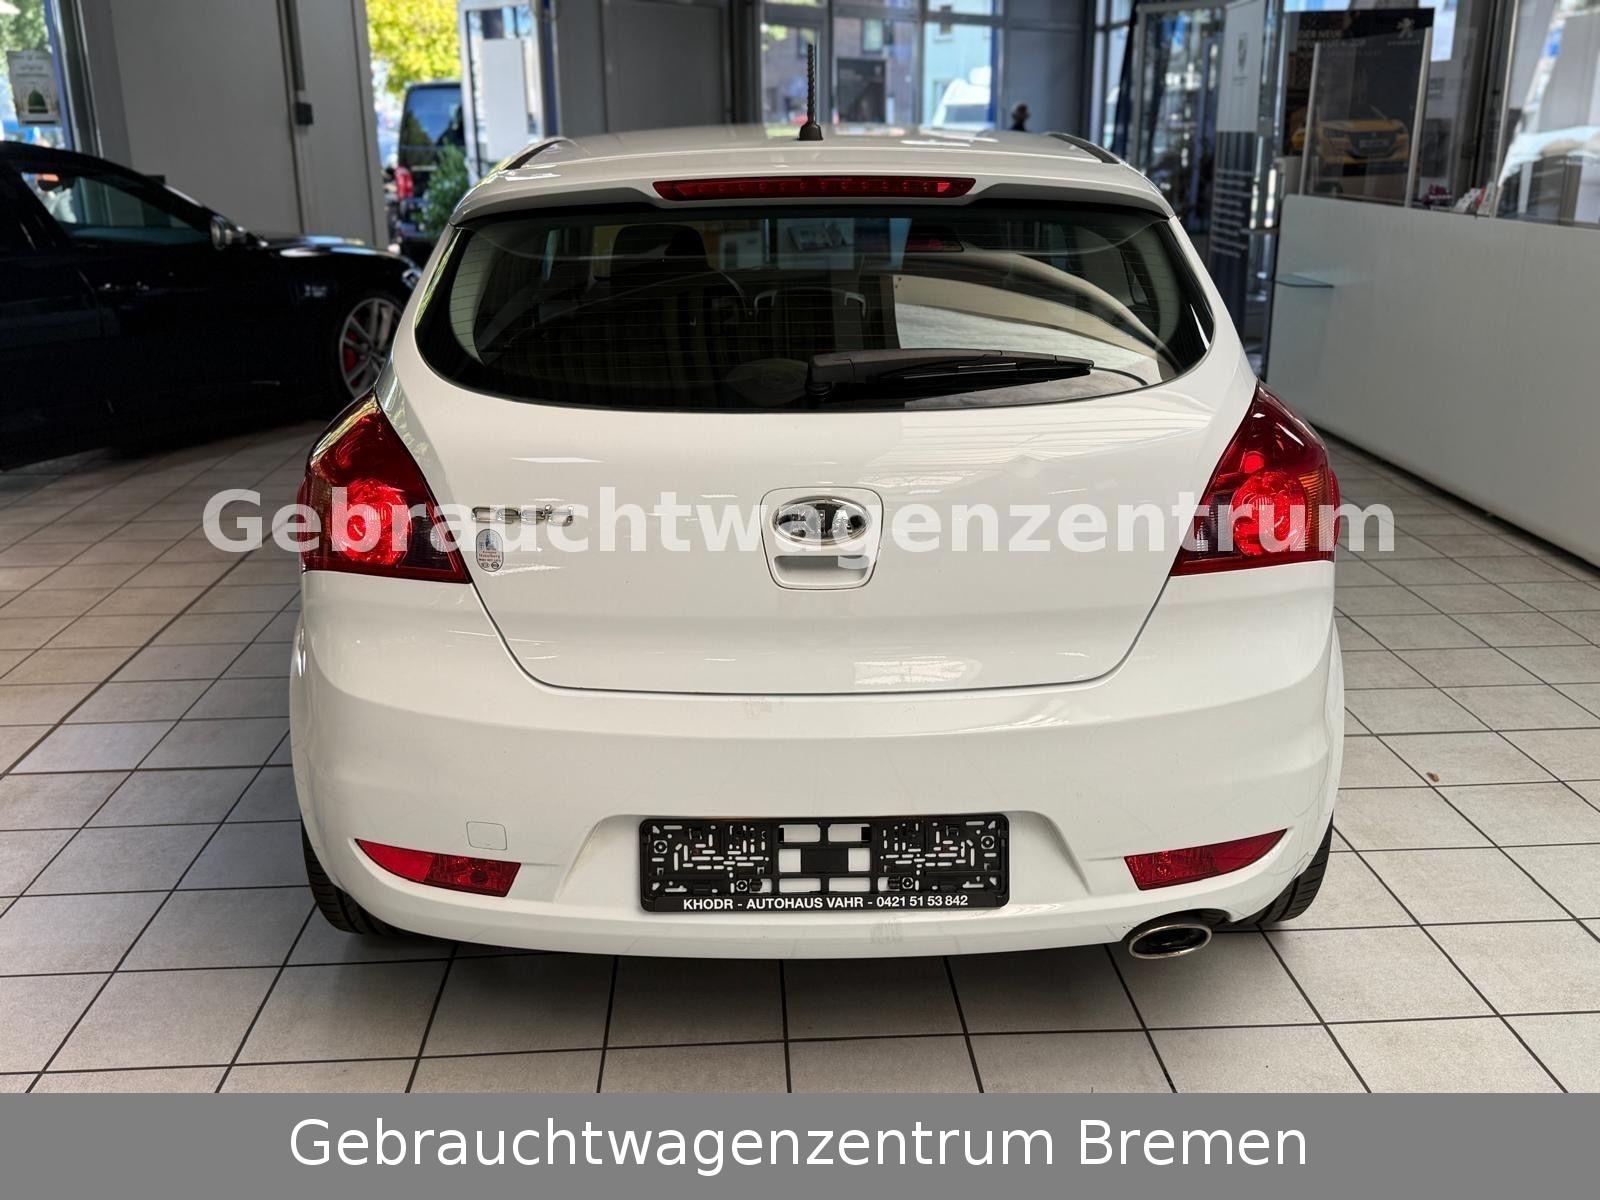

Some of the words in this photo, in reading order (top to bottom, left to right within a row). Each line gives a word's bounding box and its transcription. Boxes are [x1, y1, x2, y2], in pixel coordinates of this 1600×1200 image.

[683, 898, 734, 910] KHODR
[746, 897, 823, 909] AUTOHAUS
[826, 897, 864, 908] VAHR
[876, 896, 906, 908] 0421
[909, 896, 924, 907] 51
[927, 895, 943, 907] 53
[945, 895, 968, 907] 842
